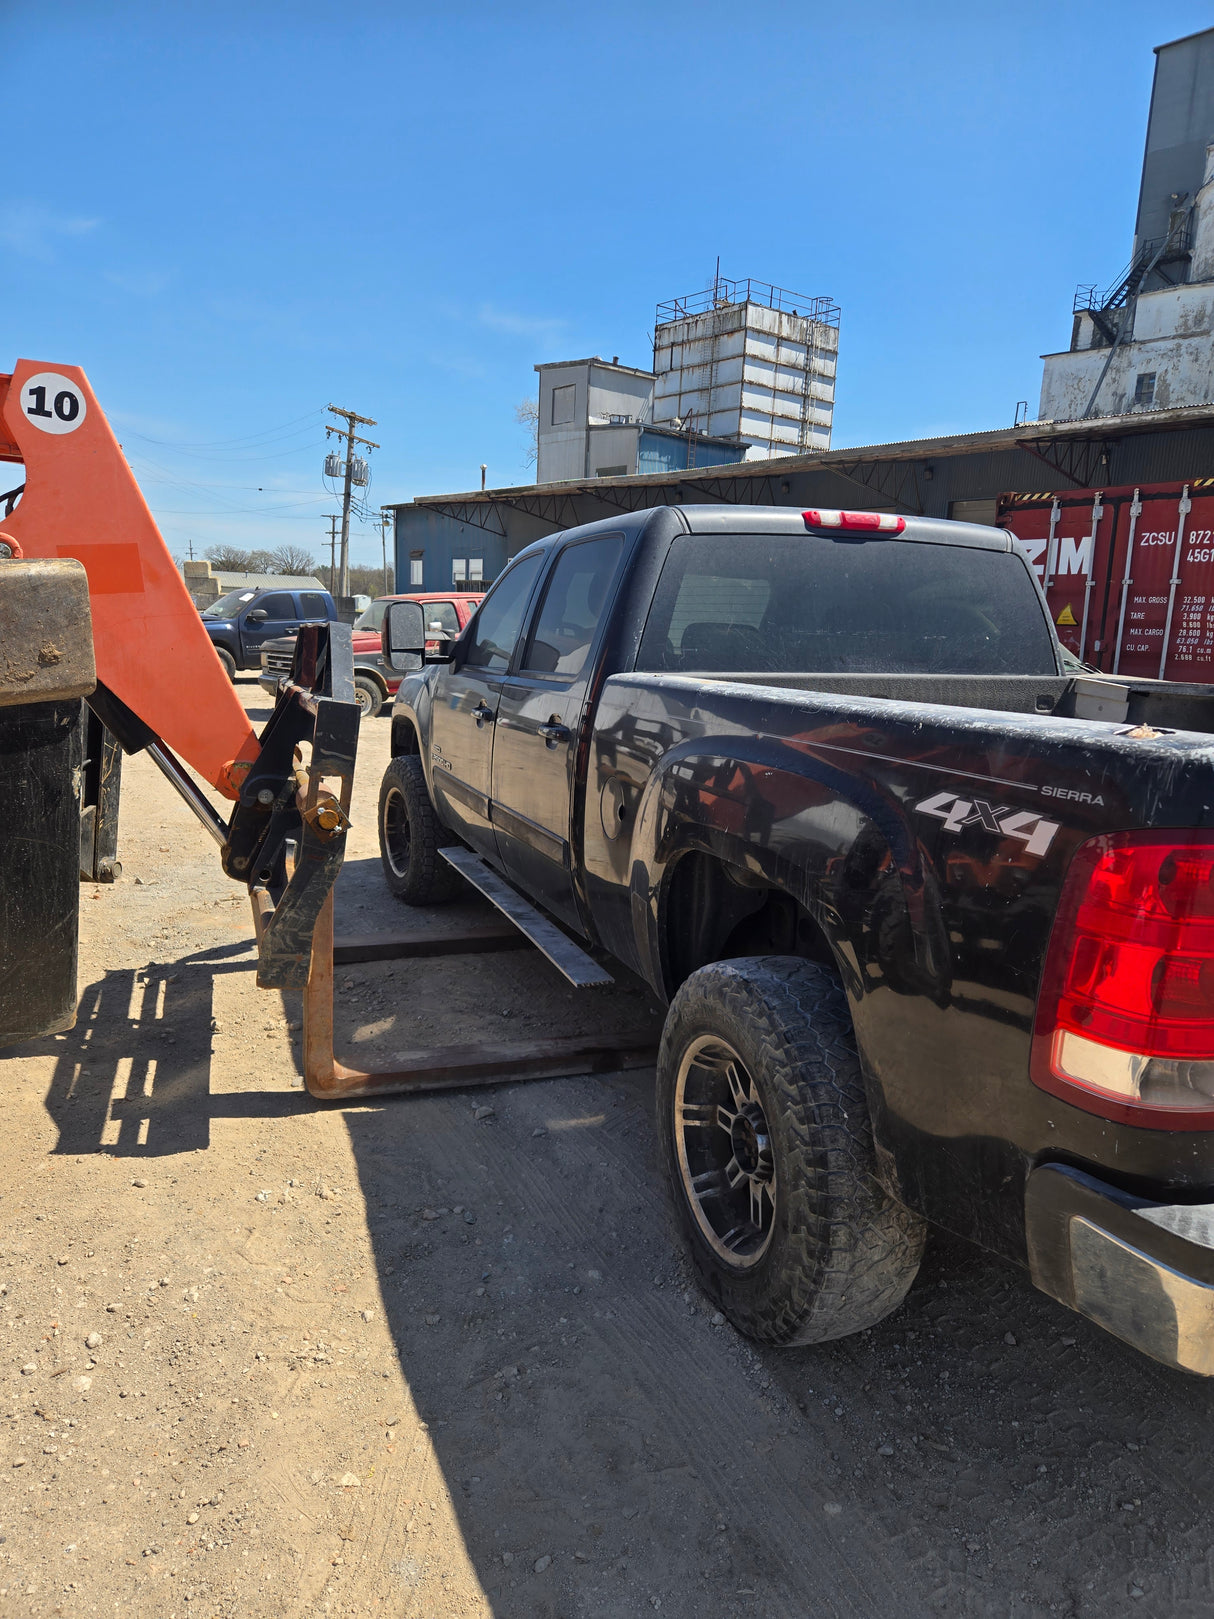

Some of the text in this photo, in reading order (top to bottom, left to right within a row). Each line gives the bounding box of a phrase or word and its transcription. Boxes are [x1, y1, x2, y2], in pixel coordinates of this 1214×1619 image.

[27, 385, 80, 422] 10
[1140, 530, 1214, 546] ZCSU 872
[1019, 536, 1093, 575] ZIM
[1148, 596, 1168, 604] GROSS
[1130, 612, 1146, 620] TARE
[1144, 628, 1164, 636] CARGO
[1206, 630, 1214, 639] kg
[1178, 645, 1193, 653] 76.1
[1040, 785, 1105, 807] SIERRA
